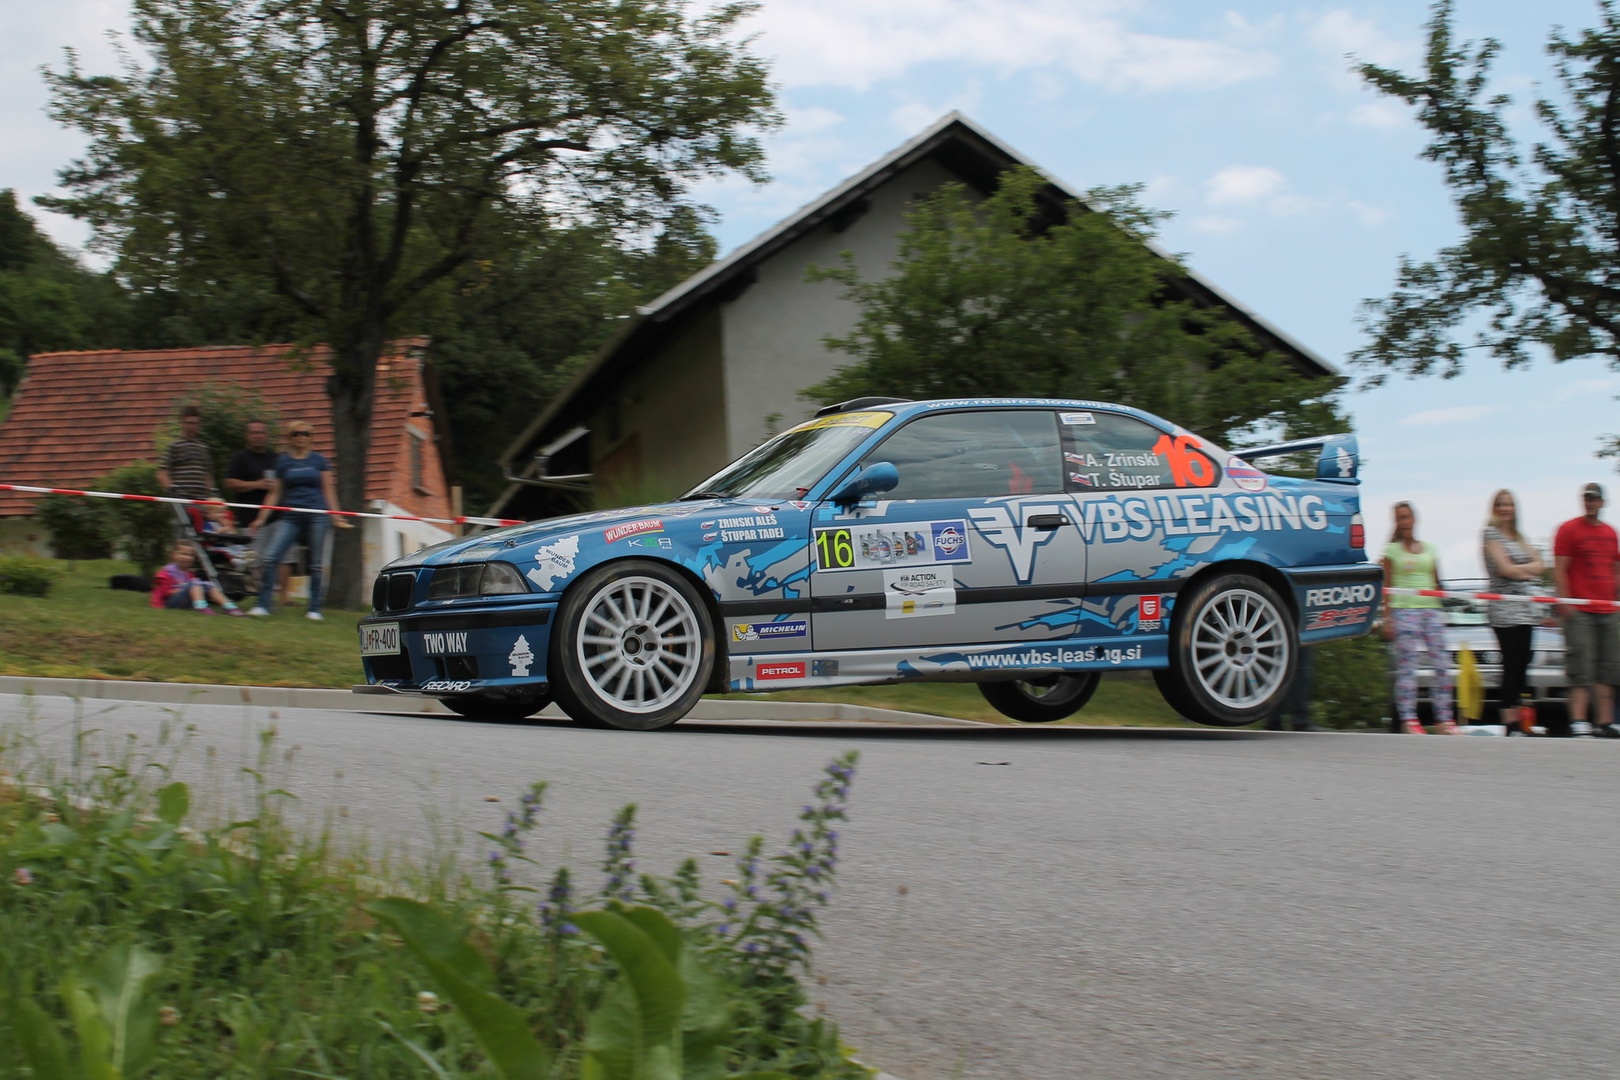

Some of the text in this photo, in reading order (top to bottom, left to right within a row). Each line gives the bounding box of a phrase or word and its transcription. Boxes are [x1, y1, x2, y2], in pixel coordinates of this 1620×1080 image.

[1086, 453, 1160, 467] A. Zrinski
[1152, 435, 1215, 487] 16
[1089, 468, 1160, 489] T. Štupar
[717, 514, 777, 529] ZRINSKI ALEŠ
[1062, 494, 1328, 541] VBS LEASING
[605, 520, 661, 541] WUNDER-BAUM
[721, 528, 784, 542] ŠTUPAR TADEJ
[936, 536, 963, 545] FUCHS
[816, 529, 853, 568] 16
[911, 573, 936, 582] ACTION
[925, 579, 947, 587] SAFETY
[1305, 584, 1375, 607] RECARO
[760, 625, 806, 634] MICHELIN
[423, 632, 468, 654] TWO WAY
[762, 667, 801, 676] PETROL
[421, 681, 471, 691] RECARO
